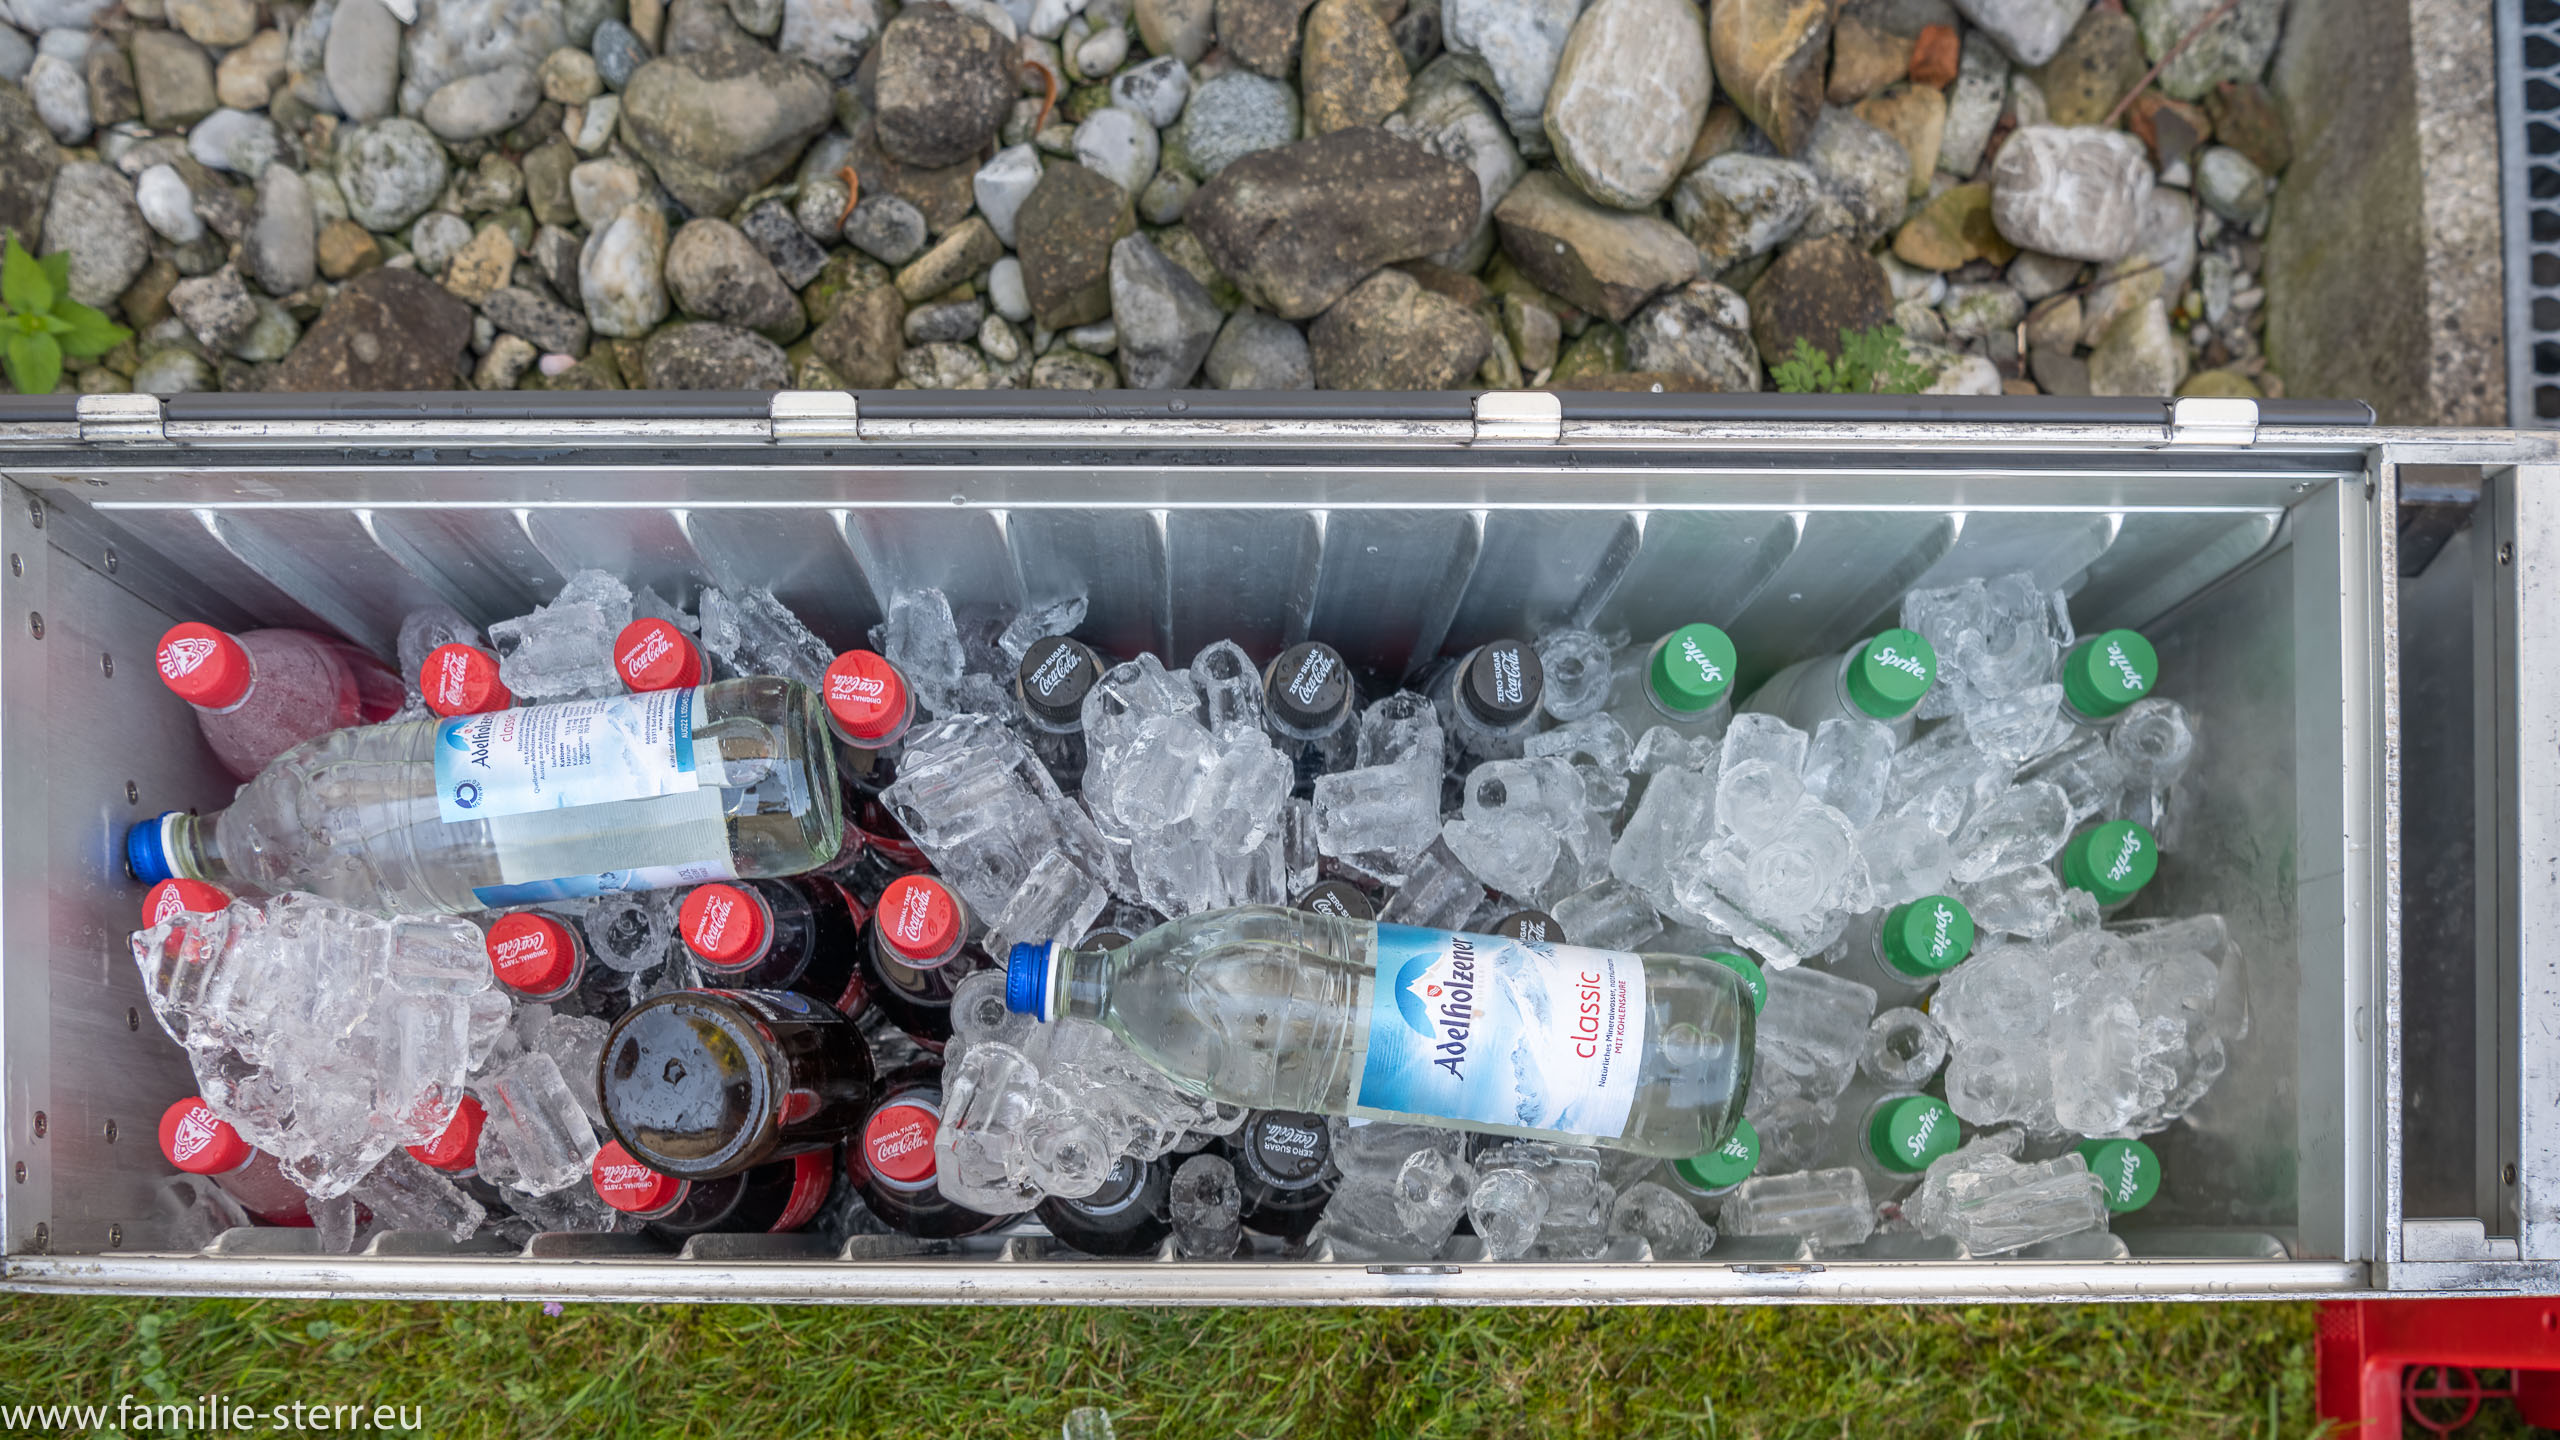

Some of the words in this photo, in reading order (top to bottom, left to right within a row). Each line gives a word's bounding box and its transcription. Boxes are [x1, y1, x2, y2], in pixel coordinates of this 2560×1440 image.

[442, 651, 450, 671] TASTE
[622, 643, 645, 664] ORIGINAL
[643, 629, 661, 647] TASTE
[1682, 640, 1723, 682] Sprite
[158, 649, 178, 679] 1783
[1030, 663, 1047, 684] ZERO
[1045, 643, 1067, 665] SUGAR
[1289, 673, 1304, 694] ZERO
[1301, 649, 1318, 674] SUGAR
[1493, 652, 1502, 679] SUGAR
[1873, 647, 1926, 678] Sprite
[2107, 644, 2143, 691] Sprite
[439, 672, 447, 703] ORIGINAL
[831, 693, 851, 701] TASTE
[851, 695, 881, 704] ORIGINAL
[1496, 680, 1505, 702] ZERO
[2108, 829, 2142, 881] Sprite
[897, 909, 908, 936] ORIGINAL
[904, 886, 914, 908] TASTE
[1327, 890, 1344, 910] ZERO
[694, 916, 708, 944] ORIGINAL
[704, 895, 716, 916] TASTE
[1932, 902, 1954, 955] Sprite
[500, 958, 520, 969] TASTE
[519, 949, 548, 963] ORIGINAL
[1434, 937, 1474, 1081] Adelholzener
[1570, 971, 1600, 1058] classic
[1615, 1033, 1624, 1054] MIT
[1598, 1044, 1612, 1087] Natürliches
[190, 1106, 219, 1130] 1783
[1907, 1107, 1939, 1158] Sprite
[873, 1130, 900, 1145] ORIGINAL
[900, 1122, 920, 1135] TASTE
[1264, 1141, 1291, 1154] SUGAR
[1292, 1148, 1313, 1157] ZERO
[604, 1183, 623, 1191] TASTE
[624, 1182, 652, 1190] ORIGINAL
[2118, 1147, 2141, 1202] Sprite
